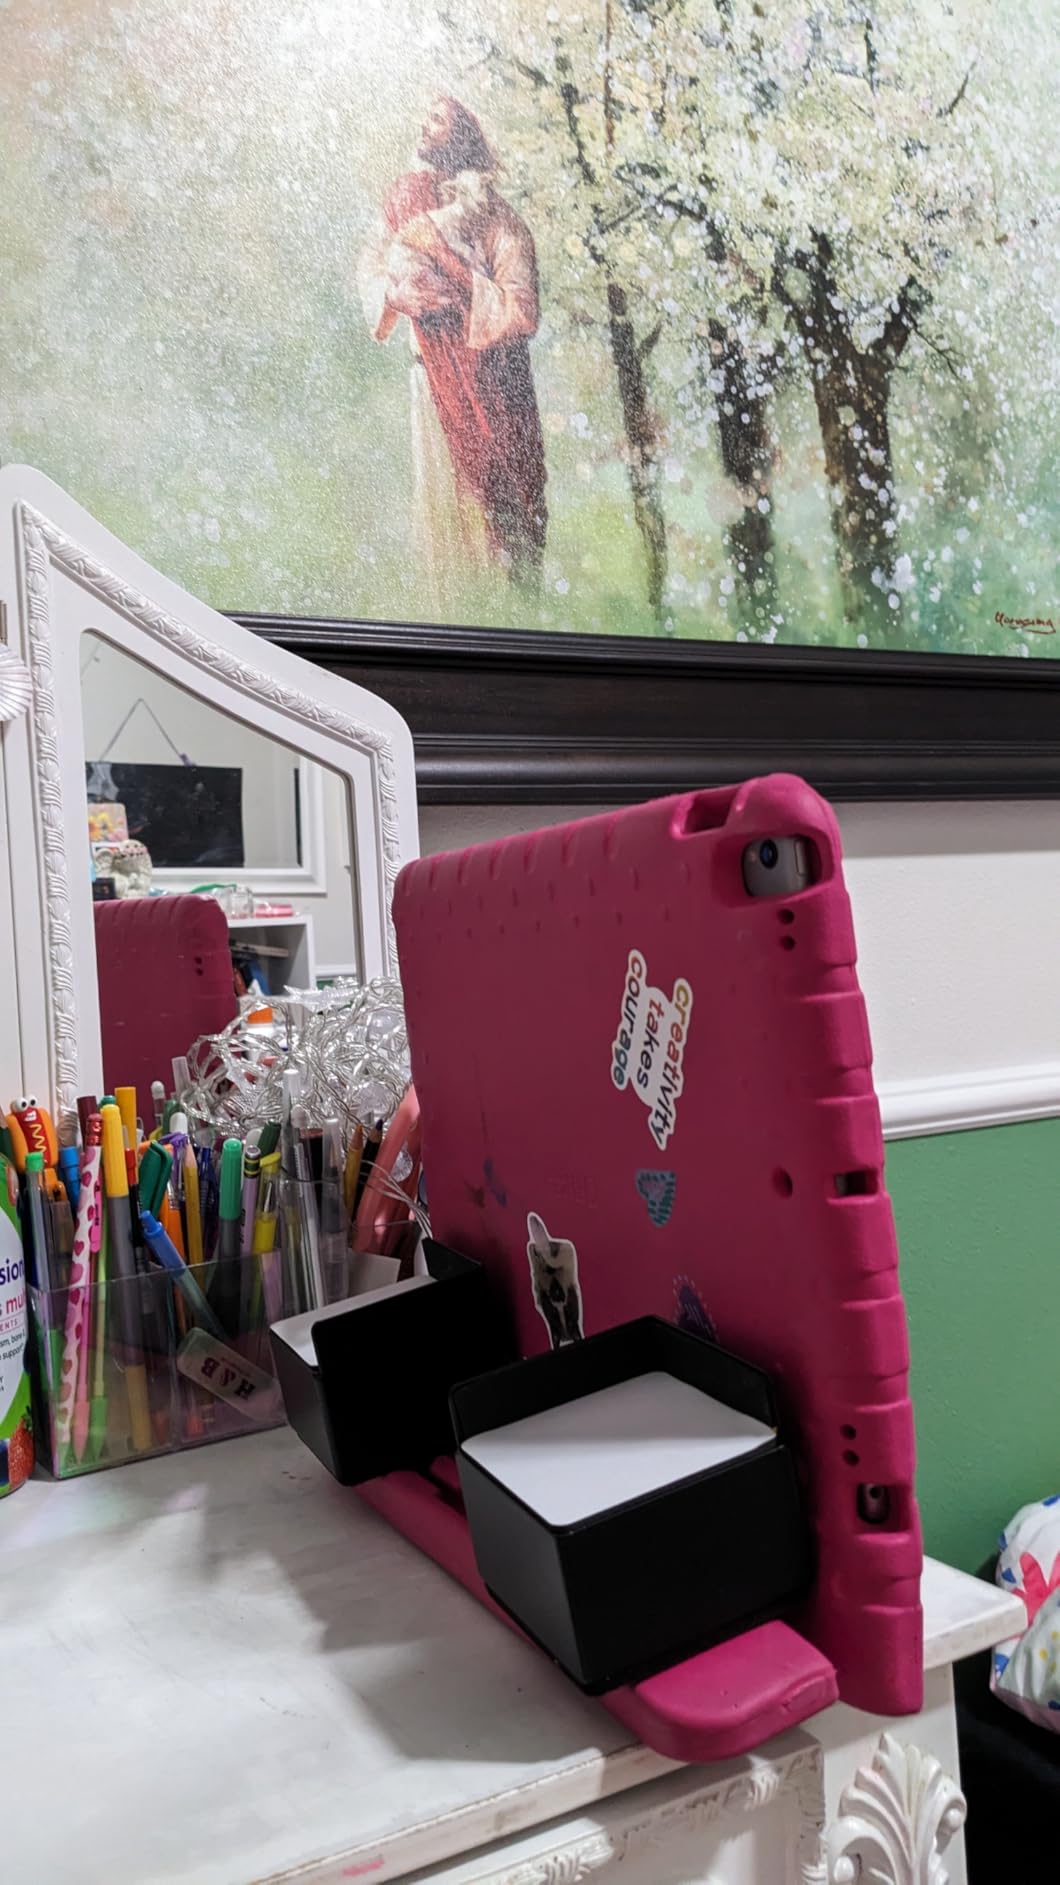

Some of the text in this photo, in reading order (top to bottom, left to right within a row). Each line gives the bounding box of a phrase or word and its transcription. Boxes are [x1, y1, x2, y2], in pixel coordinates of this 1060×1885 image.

[614, 956, 642, 1085] courage
[637, 1000, 665, 1088] takes
[651, 984, 689, 1145] creativity
